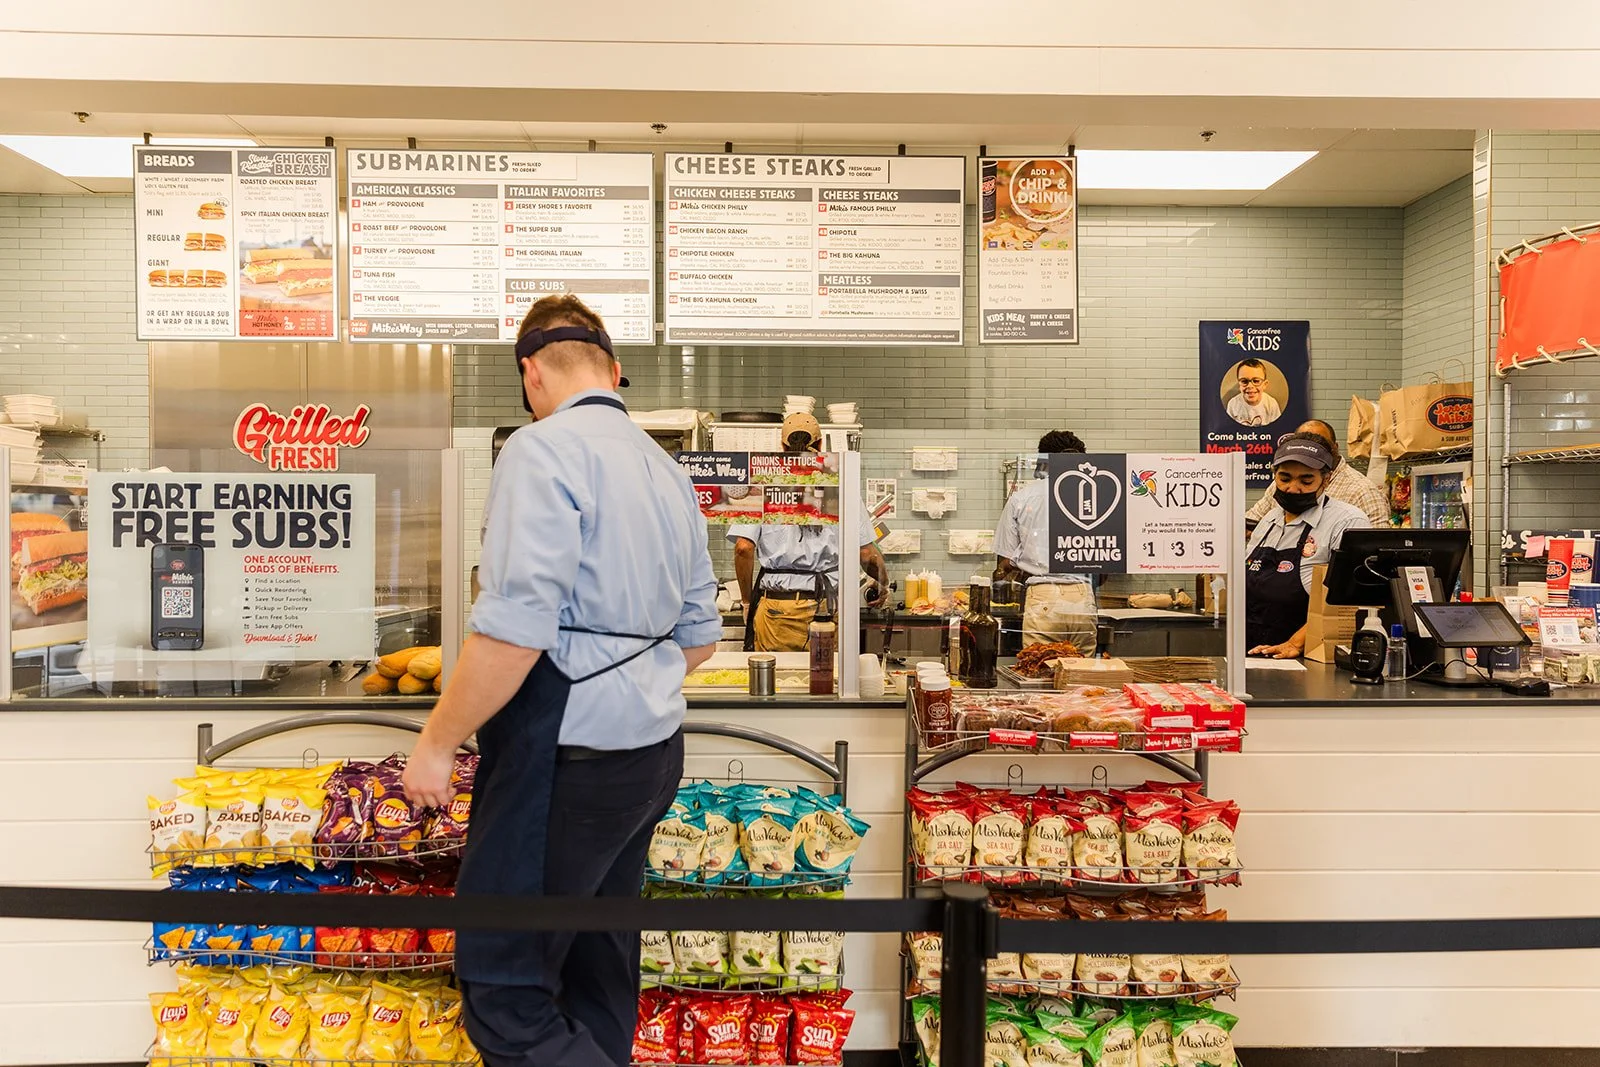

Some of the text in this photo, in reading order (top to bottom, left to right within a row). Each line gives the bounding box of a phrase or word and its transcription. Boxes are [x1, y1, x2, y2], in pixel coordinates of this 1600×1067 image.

[144, 155, 194, 167] BREADS
[274, 153, 328, 163] CHICKEN
[357, 154, 508, 172] SUBMARINES
[275, 164, 327, 175] BREAST
[674, 157, 845, 176] CHEESE STEAKS
[1018, 178, 1067, 190] CHIP &
[357, 186, 455, 195] AMERICAN CLASSICS
[510, 187, 605, 196] ITALIAN FAVORITES
[674, 189, 795, 199] CHICKEN CHEESE STEAKS
[824, 191, 898, 200] CHEESE STEAKS
[1018, 191, 1067, 204] DRINK!
[511, 281, 564, 290] CLUB SUBS
[824, 276, 871, 284] MEATLESS
[986, 313, 1025, 323] KIDS MEAL
[1247, 336, 1281, 351] KIDS
[237, 406, 368, 462] Grilled
[1236, 432, 1254, 441] back
[1206, 443, 1273, 454] March 26th
[271, 448, 336, 468] FRESH
[752, 456, 781, 467] ONIONS,
[716, 464, 746, 481] Way
[1165, 469, 1222, 479] CancerFree
[112, 483, 351, 510] START EARNING
[1166, 482, 1222, 508] KIDS
[113, 511, 351, 548] FREE SUBS!
[1058, 536, 1116, 548] MONTH
[1143, 541, 1214, 556] $1 $3 $5
[244, 556, 314, 564] ONE ACCOUNT.
[1055, 549, 1121, 562] of GIVING
[244, 565, 339, 573] LOADS OF BENEFITS.
[244, 634, 286, 643] Download
[295, 634, 317, 643] Join!
[150, 813, 194, 831] BAKED
[217, 812, 260, 823] BAKED
[264, 809, 311, 823] BAKED
[976, 824, 998, 837] Miss
[1136, 832, 1180, 848] Miss Vickie's
[1041, 845, 1053, 853] SEA
[1157, 850, 1171, 858] SALT
[162, 1004, 187, 1022] Lay's
[374, 1006, 402, 1022] Lay's
[322, 1012, 350, 1027] Lay's
[708, 1022, 740, 1044] Sun
[720, 1033, 740, 1042] CHIPS
[801, 1026, 836, 1045] Sun
[813, 1040, 833, 1048] CHIPS
